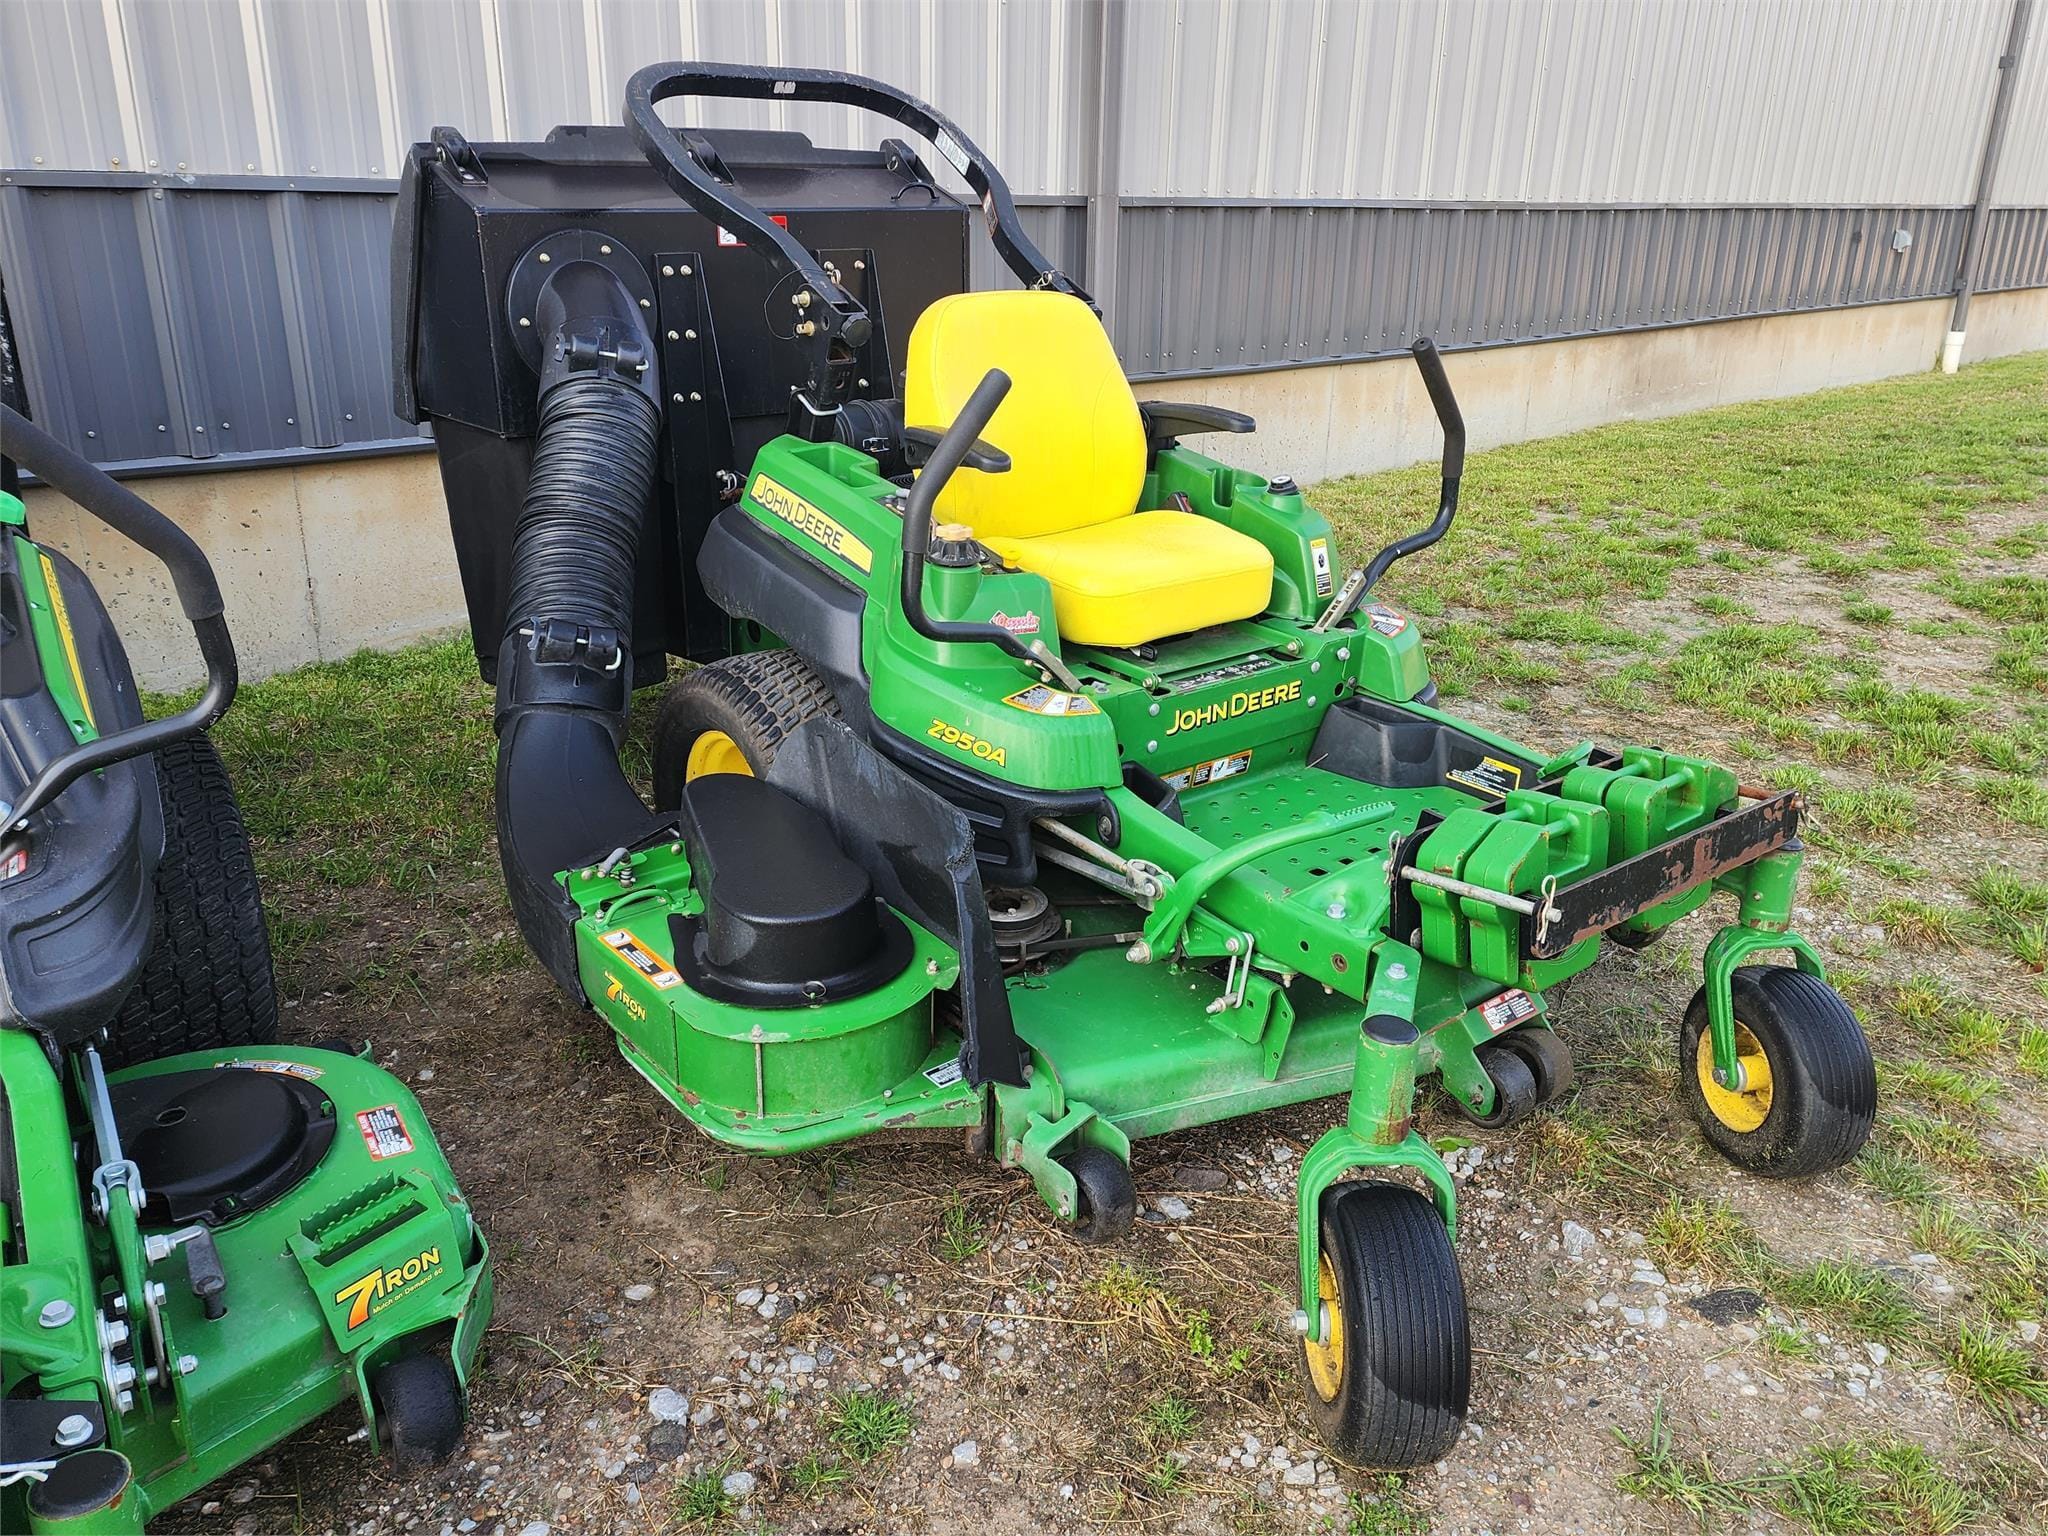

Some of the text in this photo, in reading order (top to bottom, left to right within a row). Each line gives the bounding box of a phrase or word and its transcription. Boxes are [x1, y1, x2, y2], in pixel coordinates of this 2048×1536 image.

[757, 481, 843, 551] JOHN DEERE
[1166, 680, 1302, 736] JOHN DEERE
[926, 718, 1007, 768] Z950A
[372, 1296, 394, 1314] Mulch
[394, 1292, 403, 1302] on
[404, 1274, 432, 1295] Demand
[376, 1246, 441, 1299] IRON
